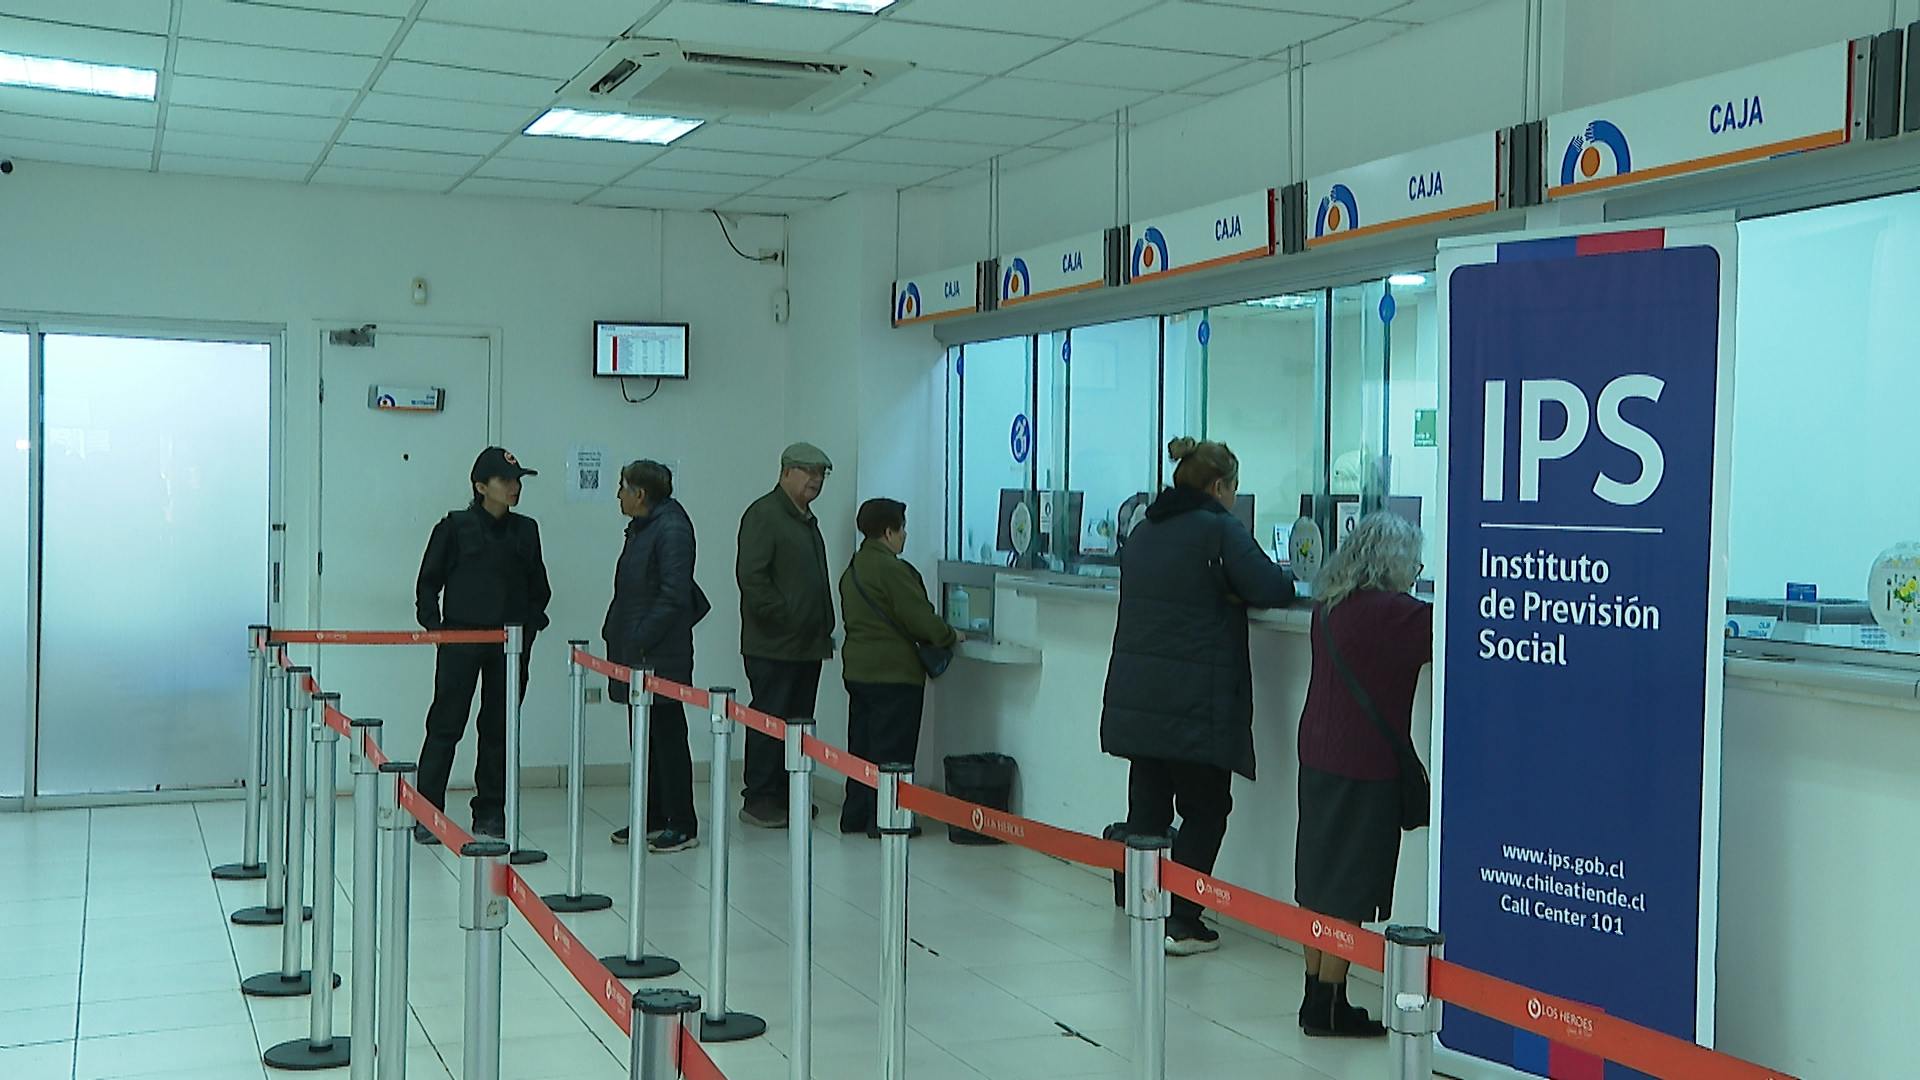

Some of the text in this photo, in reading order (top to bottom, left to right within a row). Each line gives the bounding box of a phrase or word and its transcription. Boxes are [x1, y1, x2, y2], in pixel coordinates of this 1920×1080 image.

[1709, 95, 1763, 135] CAJA
[1408, 171, 1443, 201] CAJA
[1215, 215, 1242, 242] CAJA
[1062, 251, 1083, 273] CAJA
[944, 280, 960, 299] CAJA
[1481, 373, 1666, 506] IPS
[1480, 547, 1609, 584] Instituto
[1479, 588, 1661, 630] de Previsión
[1478, 628, 1567, 666] Social
[1501, 843, 1626, 880] www.ips.gob.cl
[1480, 865, 1647, 912] www.chileatiende.cl
[1500, 894, 1625, 936] Call Center 101
[1541, 1003, 1593, 1031] LOS HEROES
